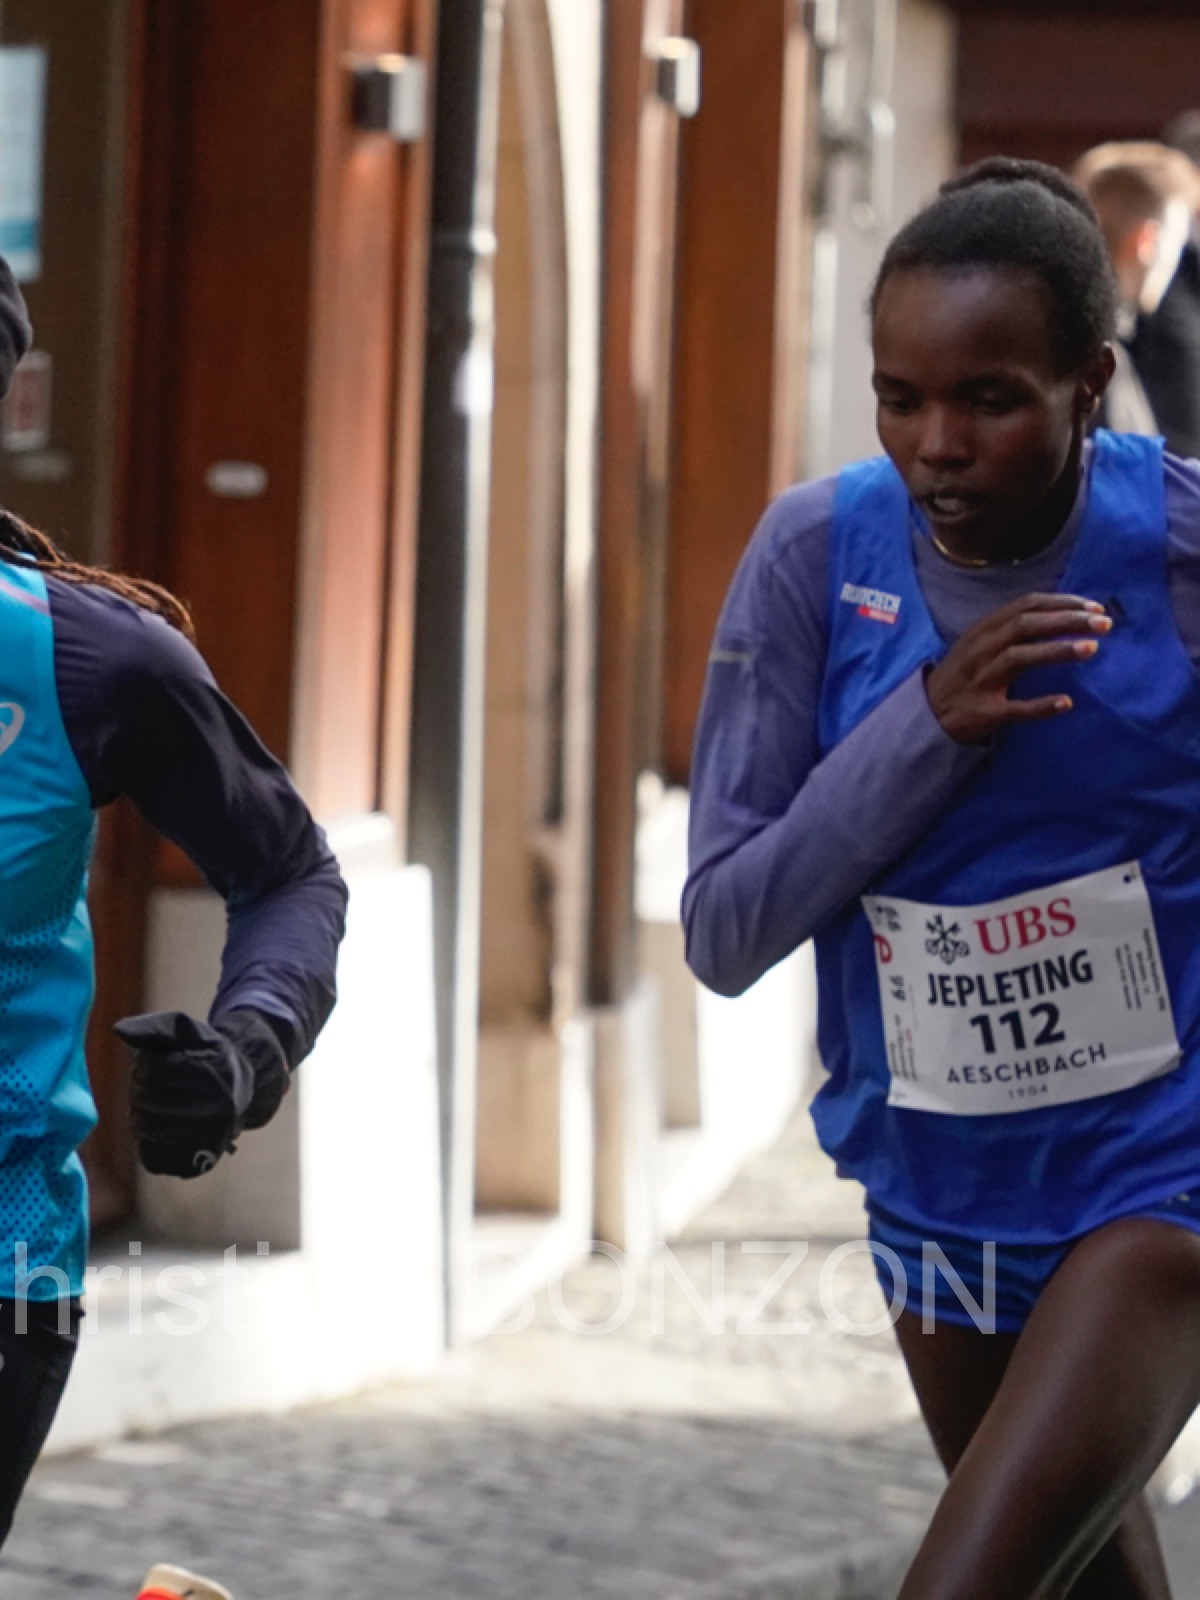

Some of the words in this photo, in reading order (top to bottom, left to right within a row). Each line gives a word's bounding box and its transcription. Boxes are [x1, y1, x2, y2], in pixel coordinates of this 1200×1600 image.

[973, 898, 1077, 955] UBS
[927, 949, 1093, 1008] JEPLETING
[969, 1003, 1066, 1054] 112
[947, 1043, 1107, 1085] AESCHBACH
[1008, 1084, 1049, 1100] 1904
